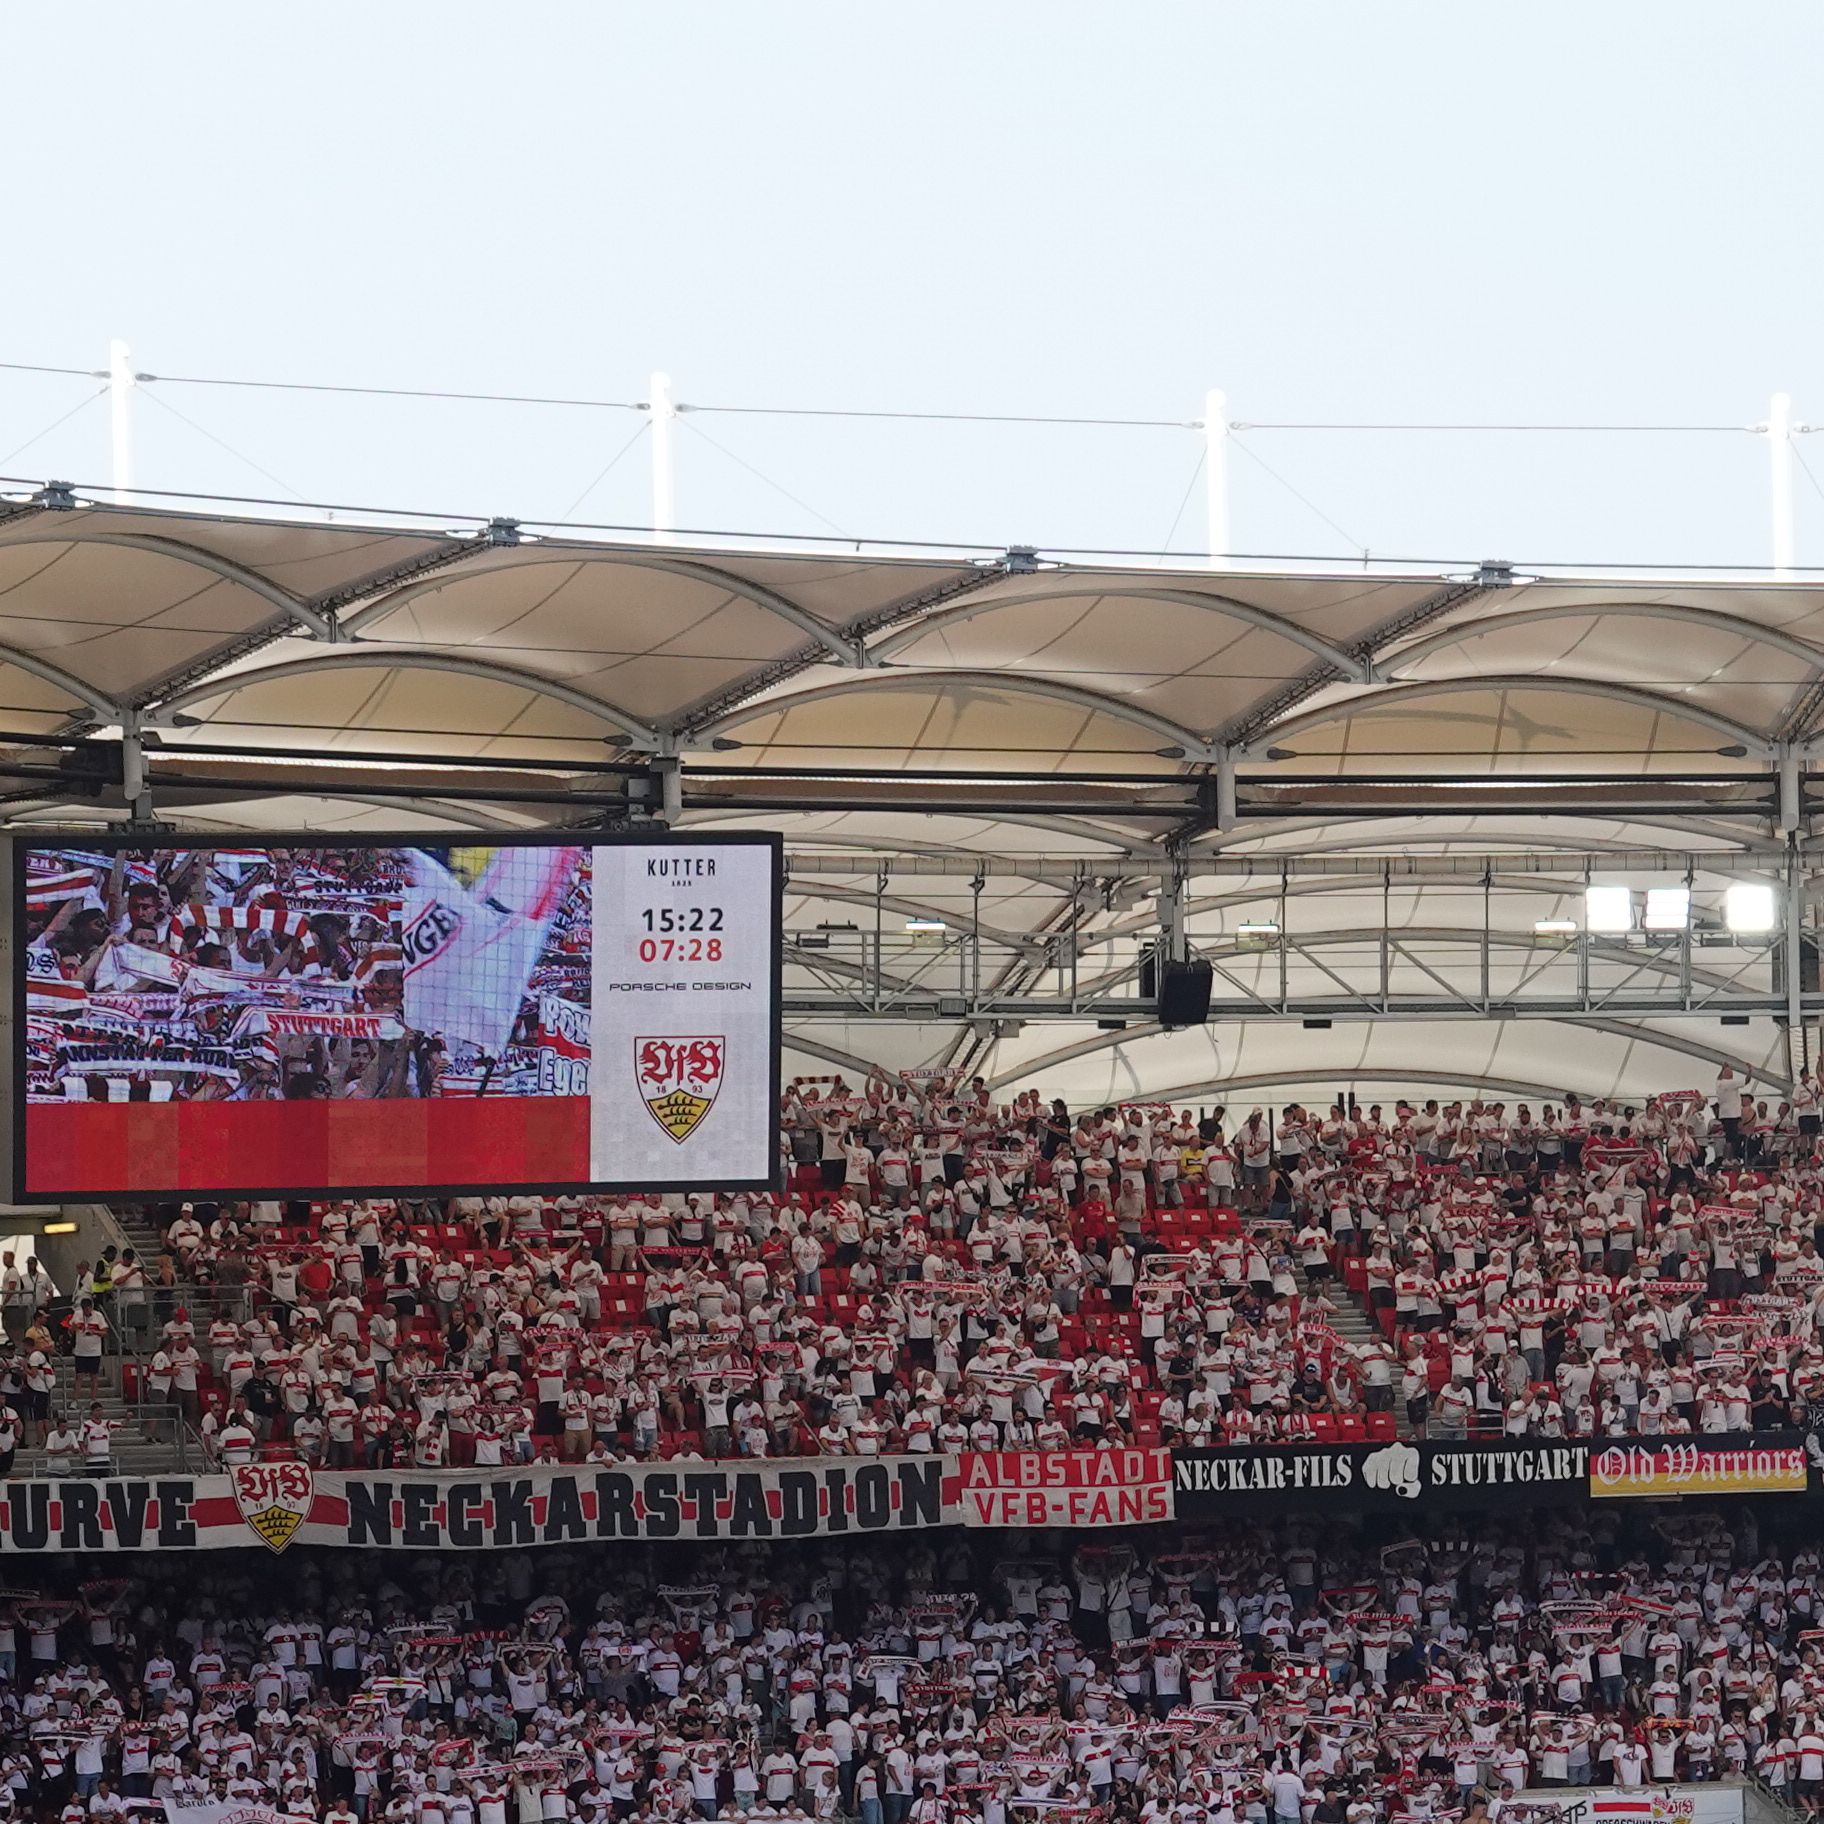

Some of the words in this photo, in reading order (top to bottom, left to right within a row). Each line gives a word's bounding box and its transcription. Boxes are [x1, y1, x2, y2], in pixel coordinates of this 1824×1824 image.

[648, 858, 716, 876] KUTTER
[641, 907, 724, 932] 15:22
[639, 938, 723, 962] 07:28
[609, 982, 687, 992] PORSCHE
[692, 982, 752, 991] DESIGN
[267, 1012, 381, 1038] STUTTGART
[639, 1039, 722, 1086] VfB
[967, 1446, 1174, 1488] ALBSTADT
[1175, 1454, 1353, 1493] NECKAR-FILS
[1430, 1446, 1589, 1486] STUTTGART
[1596, 1445, 1656, 1487] Old
[1661, 1439, 1806, 1485] Warriors
[236, 1465, 313, 1502] VfB
[345, 1458, 945, 1548] NECKARSTADION
[967, 1488, 1169, 1526] VFB-FANS
